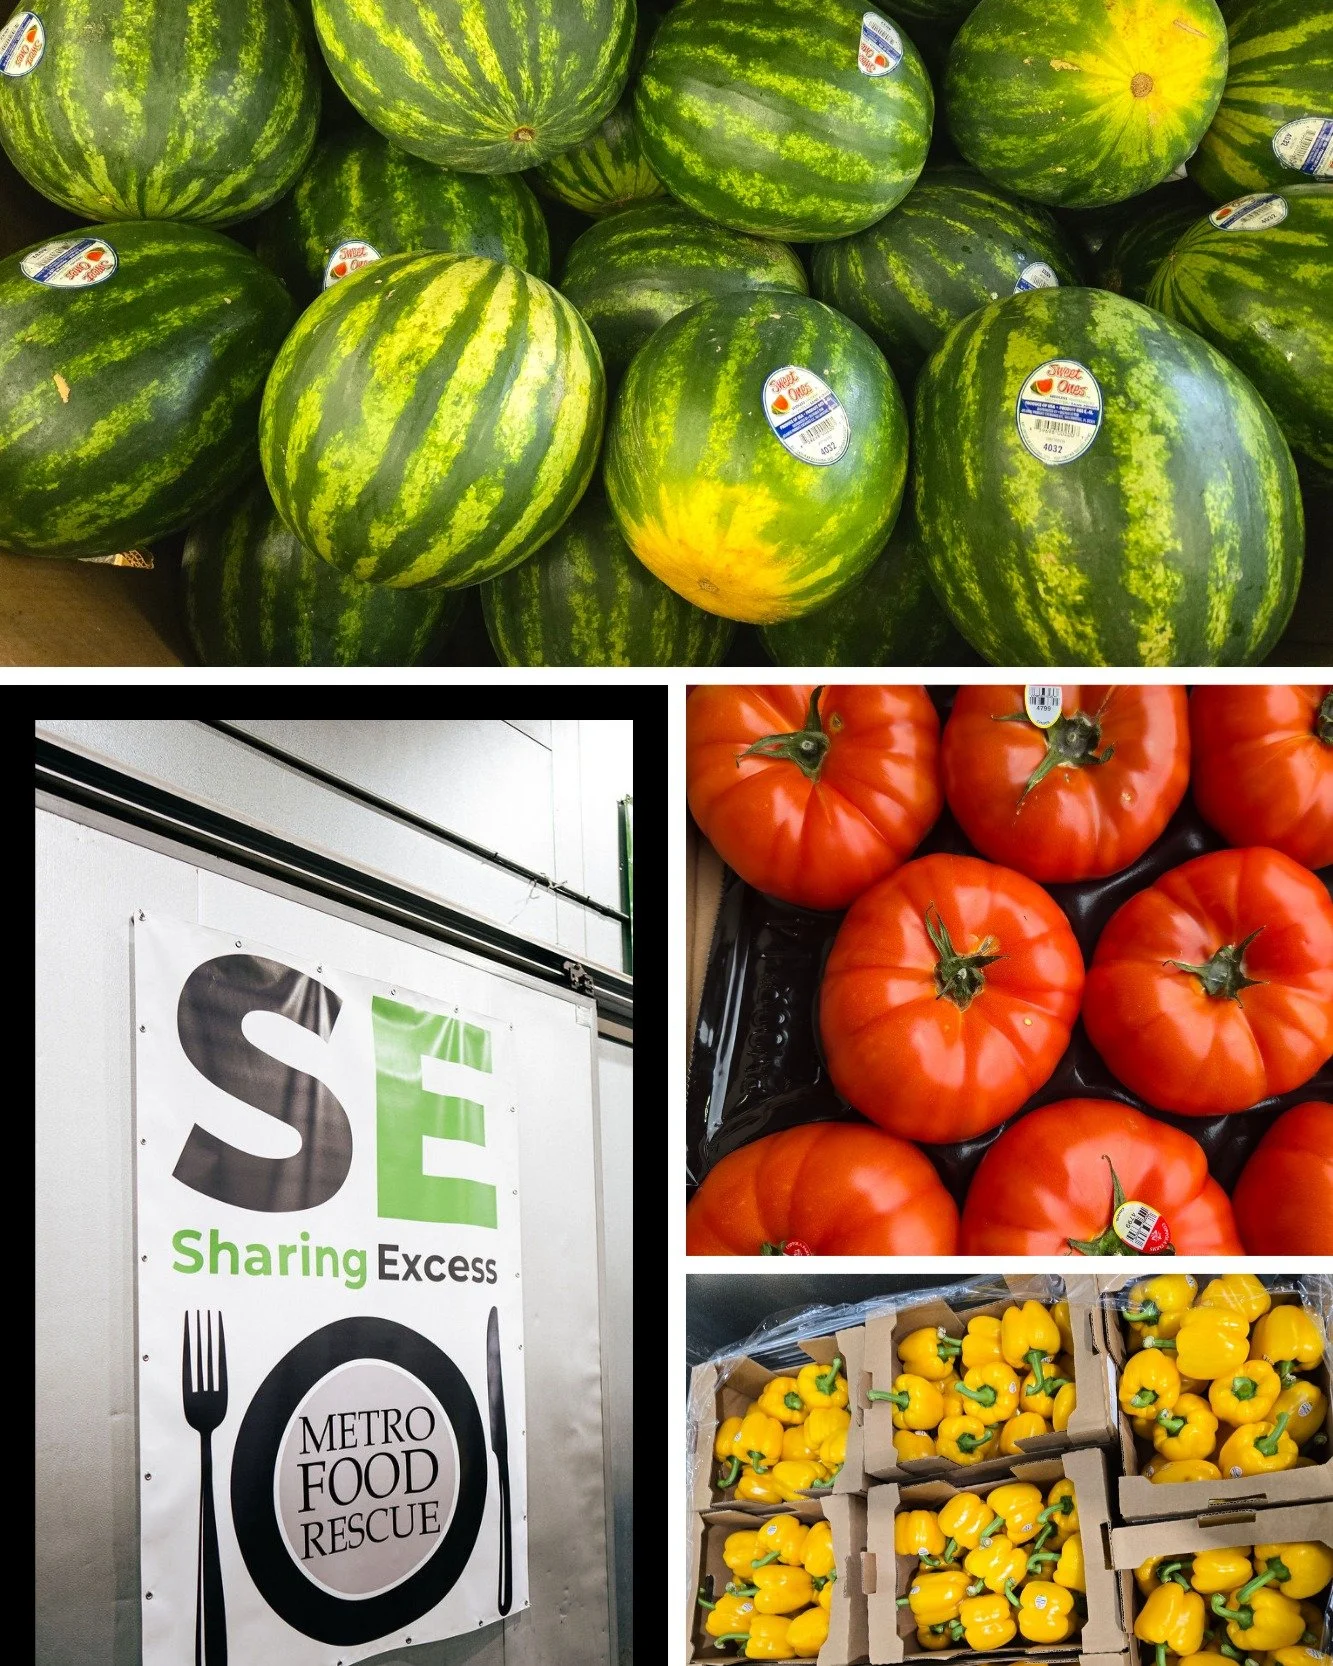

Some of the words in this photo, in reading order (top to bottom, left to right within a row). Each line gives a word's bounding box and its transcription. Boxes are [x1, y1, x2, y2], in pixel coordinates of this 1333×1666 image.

[769, 370, 800, 393] Sweet
[1047, 364, 1083, 379] Sweet
[788, 382, 812, 401] Ones
[1057, 380, 1088, 397] Ones
[820, 441, 837, 455] 4032
[1043, 443, 1063, 454] 4032
[171, 954, 497, 1229] SE
[1125, 1212, 1136, 1229] 4799
[172, 1229, 367, 1290] Sharing
[377, 1243, 498, 1285] Excess
[299, 1406, 435, 1455] METRO
[297, 1448, 439, 1513] FOOD
[300, 1501, 441, 1560] RESCUE
